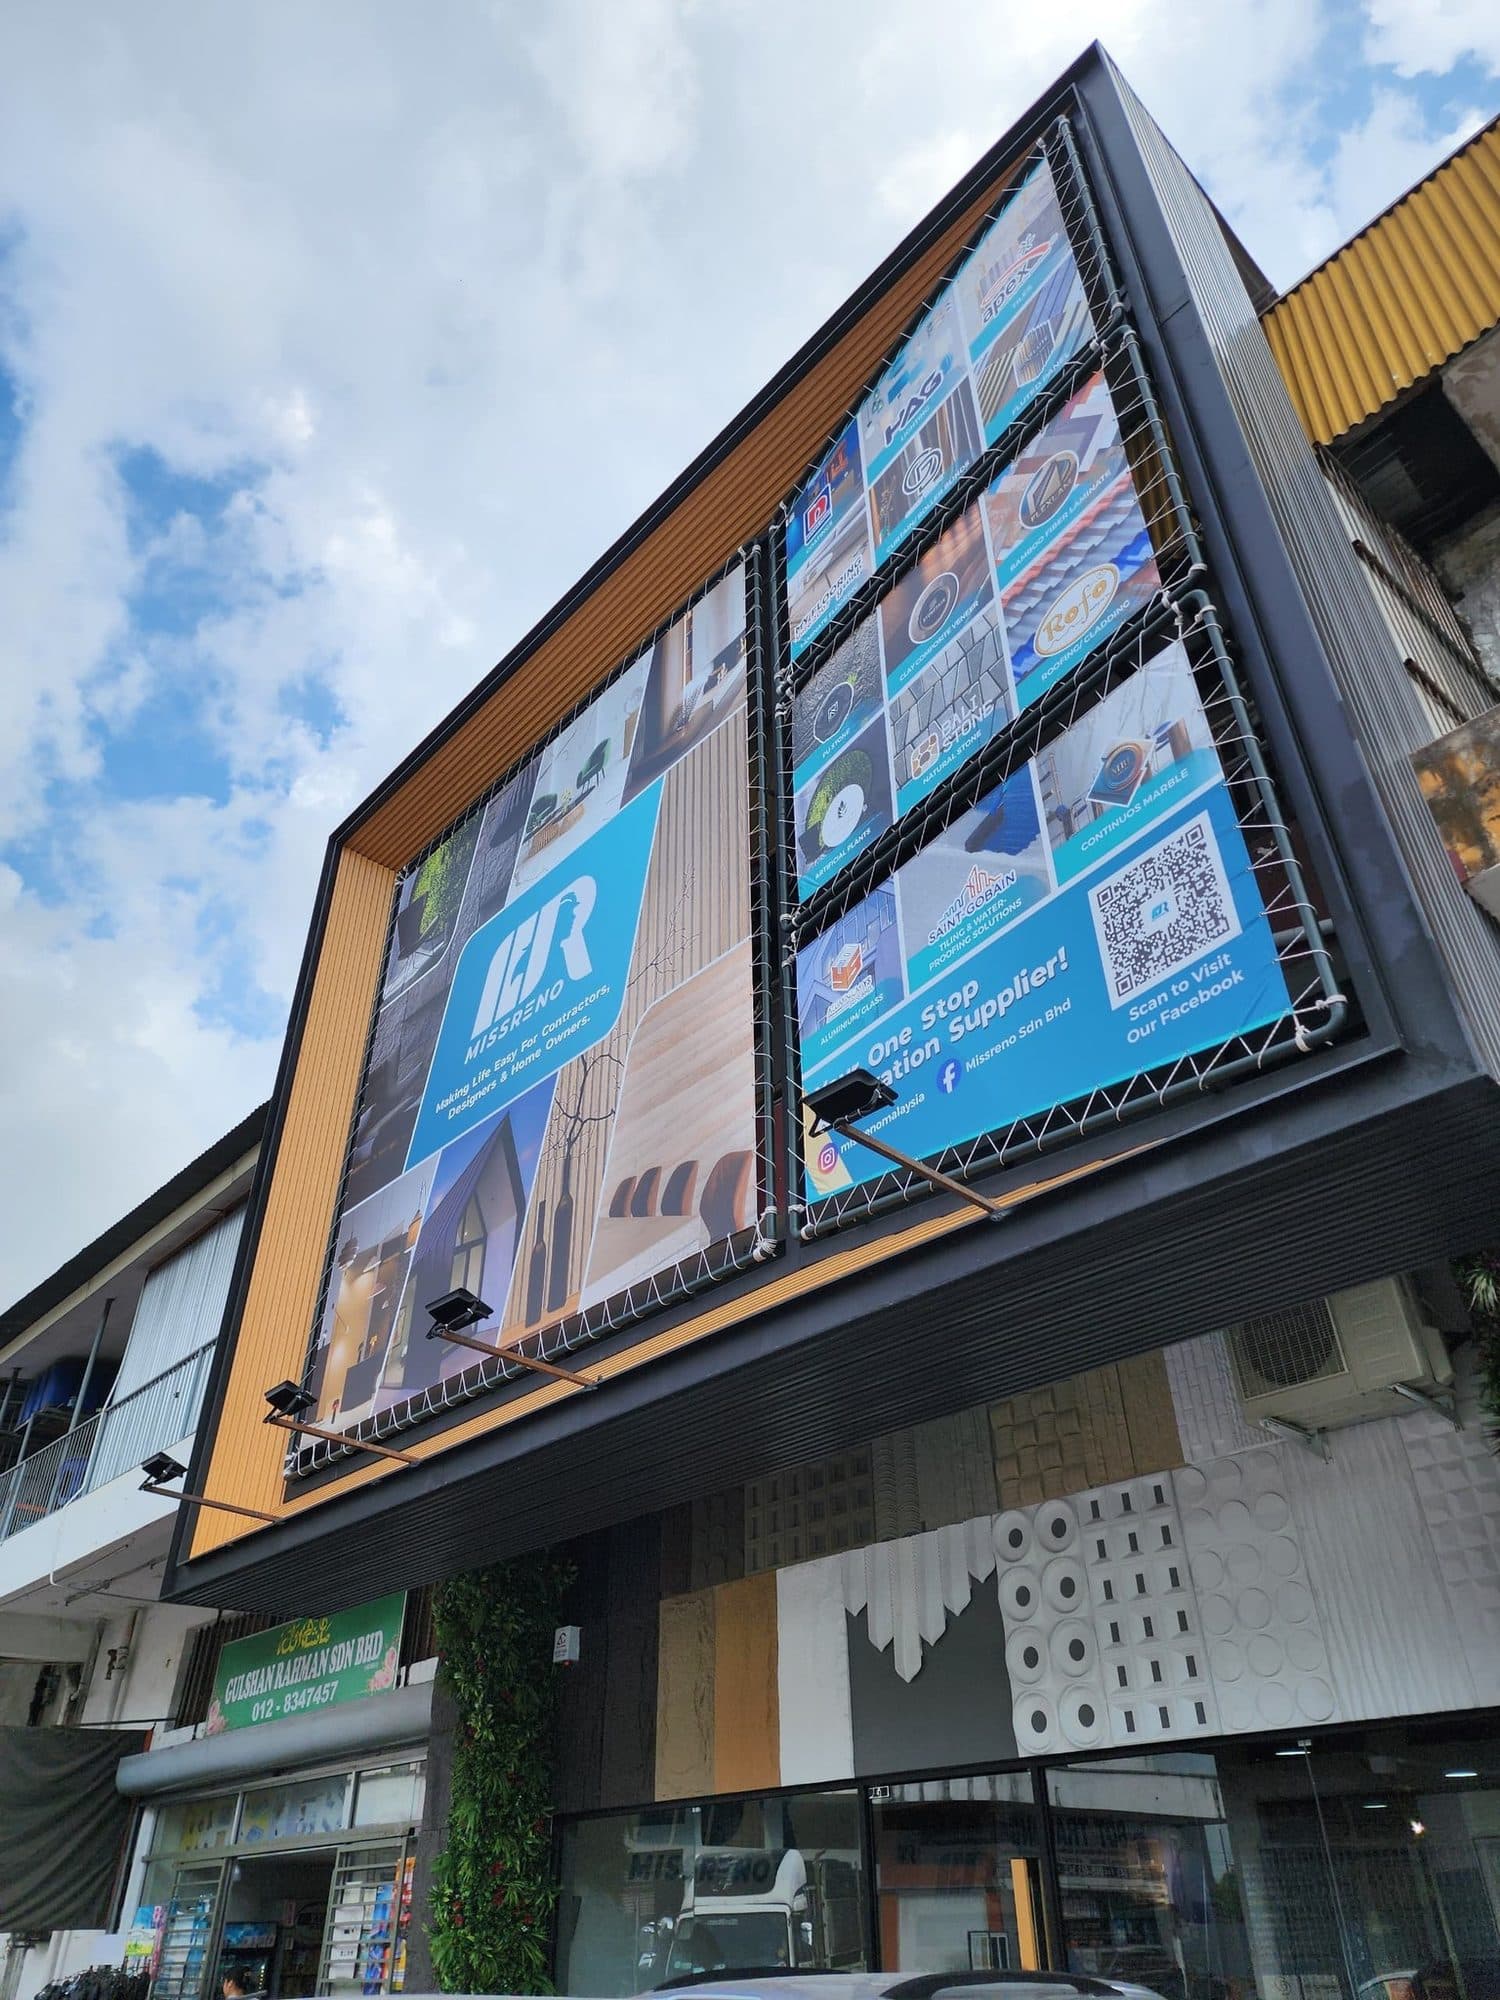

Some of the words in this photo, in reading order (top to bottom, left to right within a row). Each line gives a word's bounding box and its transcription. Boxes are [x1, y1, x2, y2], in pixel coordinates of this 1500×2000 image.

[983, 263, 1029, 323] apex
[1011, 379, 1042, 416] FLUTED
[1009, 534, 1044, 572] BAMBOO
[1045, 511, 1068, 537] FIBER
[1068, 468, 1111, 514] LAMINATE
[812, 556, 860, 616] FLOORING
[1041, 578, 1107, 641] Rofo
[1082, 597, 1129, 645] CLADDING
[899, 662, 914, 683] CLAY
[916, 626, 951, 666] COMPOSITE
[951, 599, 978, 631] VENEER
[941, 694, 978, 739] BALI
[942, 696, 994, 755] STONE
[923, 751, 955, 787] NATURAL
[956, 727, 981, 757] STONE
[1080, 802, 1141, 852] CONTINUOS
[1143, 767, 1189, 806] MARBLE
[815, 847, 845, 882] ARTIFICIAL
[847, 825, 870, 853] PLANTS
[928, 870, 1015, 944] SAINT-GOBAIN
[929, 934, 971, 971] PROOFING
[972, 897, 1021, 939] SOLUTIONS
[939, 928, 963, 951] TILING
[973, 896, 1006, 926] WATER-
[465, 977, 564, 1063] MISSRENO
[861, 992, 883, 1014] GLASS
[876, 1033, 939, 1091] ation
[948, 945, 1068, 1043] Supplier!
[1126, 1017, 1158, 1045] Our
[1160, 967, 1244, 1026] Facebook
[1128, 989, 1168, 1022] Scan
[1171, 976, 1190, 997] to
[1191, 950, 1233, 985] Visit
[435, 1079, 470, 1114] Making
[472, 1064, 491, 1088] Life
[494, 1047, 516, 1075] Easy
[521, 1032, 537, 1053] For
[541, 980, 609, 1039] Contractors,
[867, 1023, 912, 1069] One
[920, 976, 979, 1032] Stop
[966, 1032, 1016, 1073] Missreno
[1018, 1015, 1042, 1039] Sdn
[1044, 996, 1072, 1023] Bhd
[447, 1076, 497, 1122] Designers
[500, 1069, 508, 1083] &
[511, 1045, 541, 1075] Home
[545, 1009, 591, 1052] Owners.
[840, 1090, 925, 1154] misenomalaysia
[225, 1664, 275, 1704] GULSHAN
[274, 1648, 329, 1689] RAHMAN
[329, 1638, 355, 1673] SDN
[355, 1630, 383, 1665] BHD
[252, 1698, 273, 1722] 012
[284, 1681, 339, 1713] 8347457
